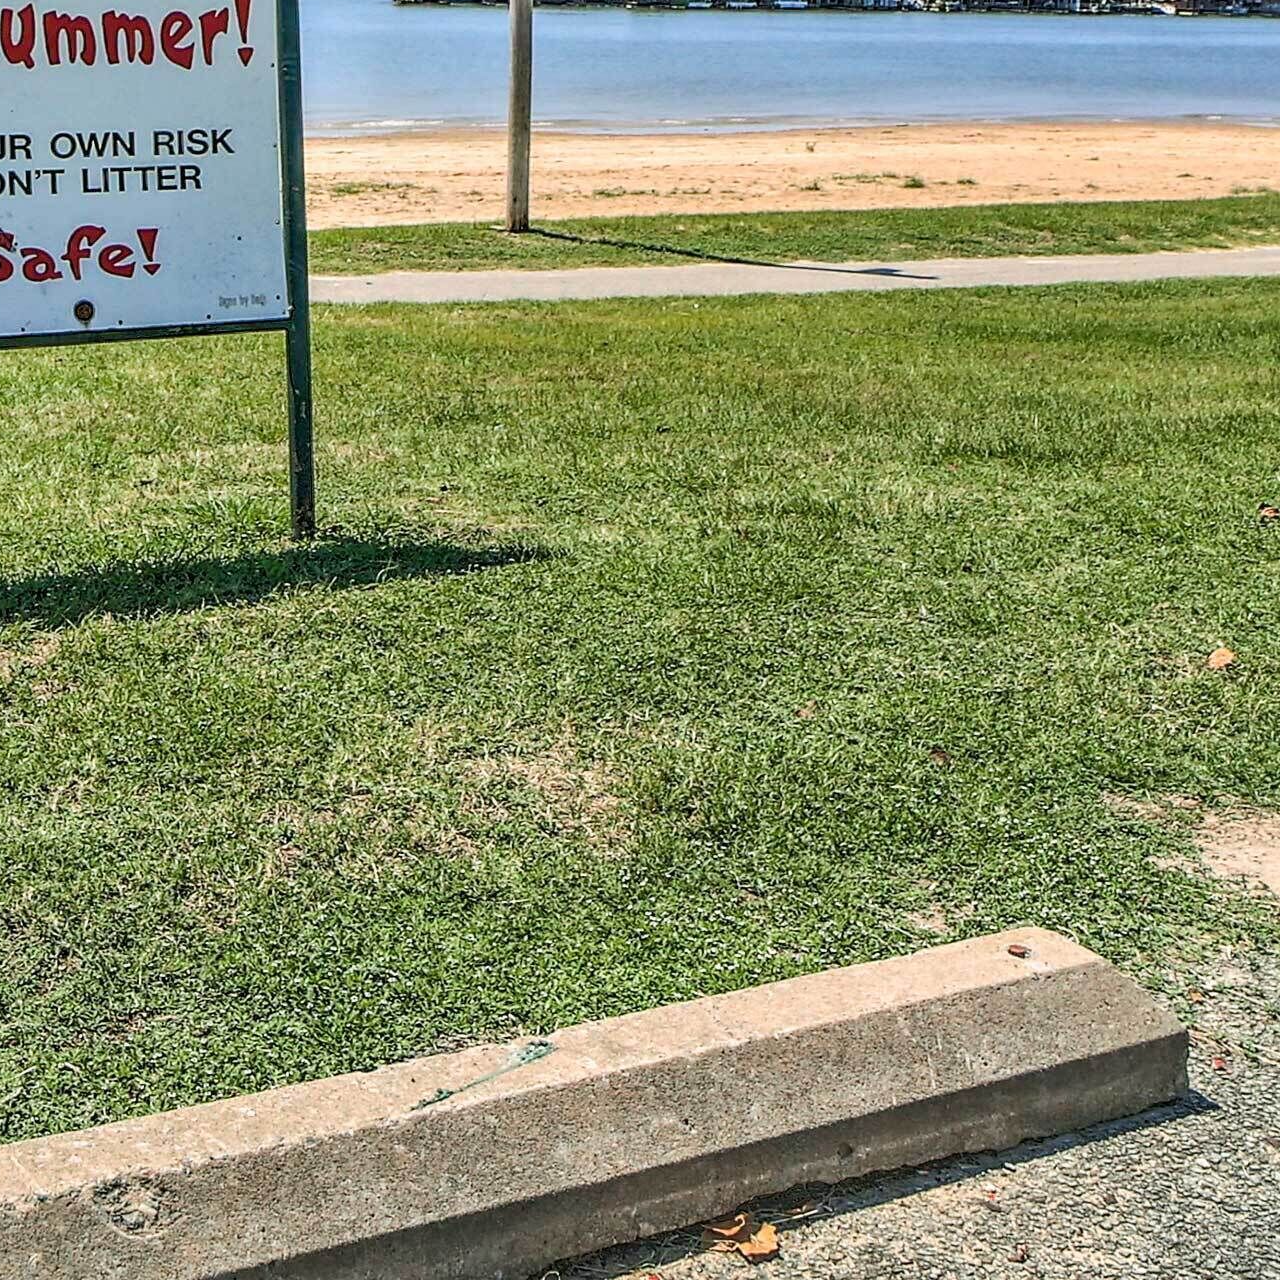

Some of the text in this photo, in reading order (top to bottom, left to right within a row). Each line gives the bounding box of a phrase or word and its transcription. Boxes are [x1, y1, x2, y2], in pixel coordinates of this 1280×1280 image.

[49, 130, 136, 159] OWN
[152, 128, 236, 156] RISK
[80, 165, 203, 194] LITTER
